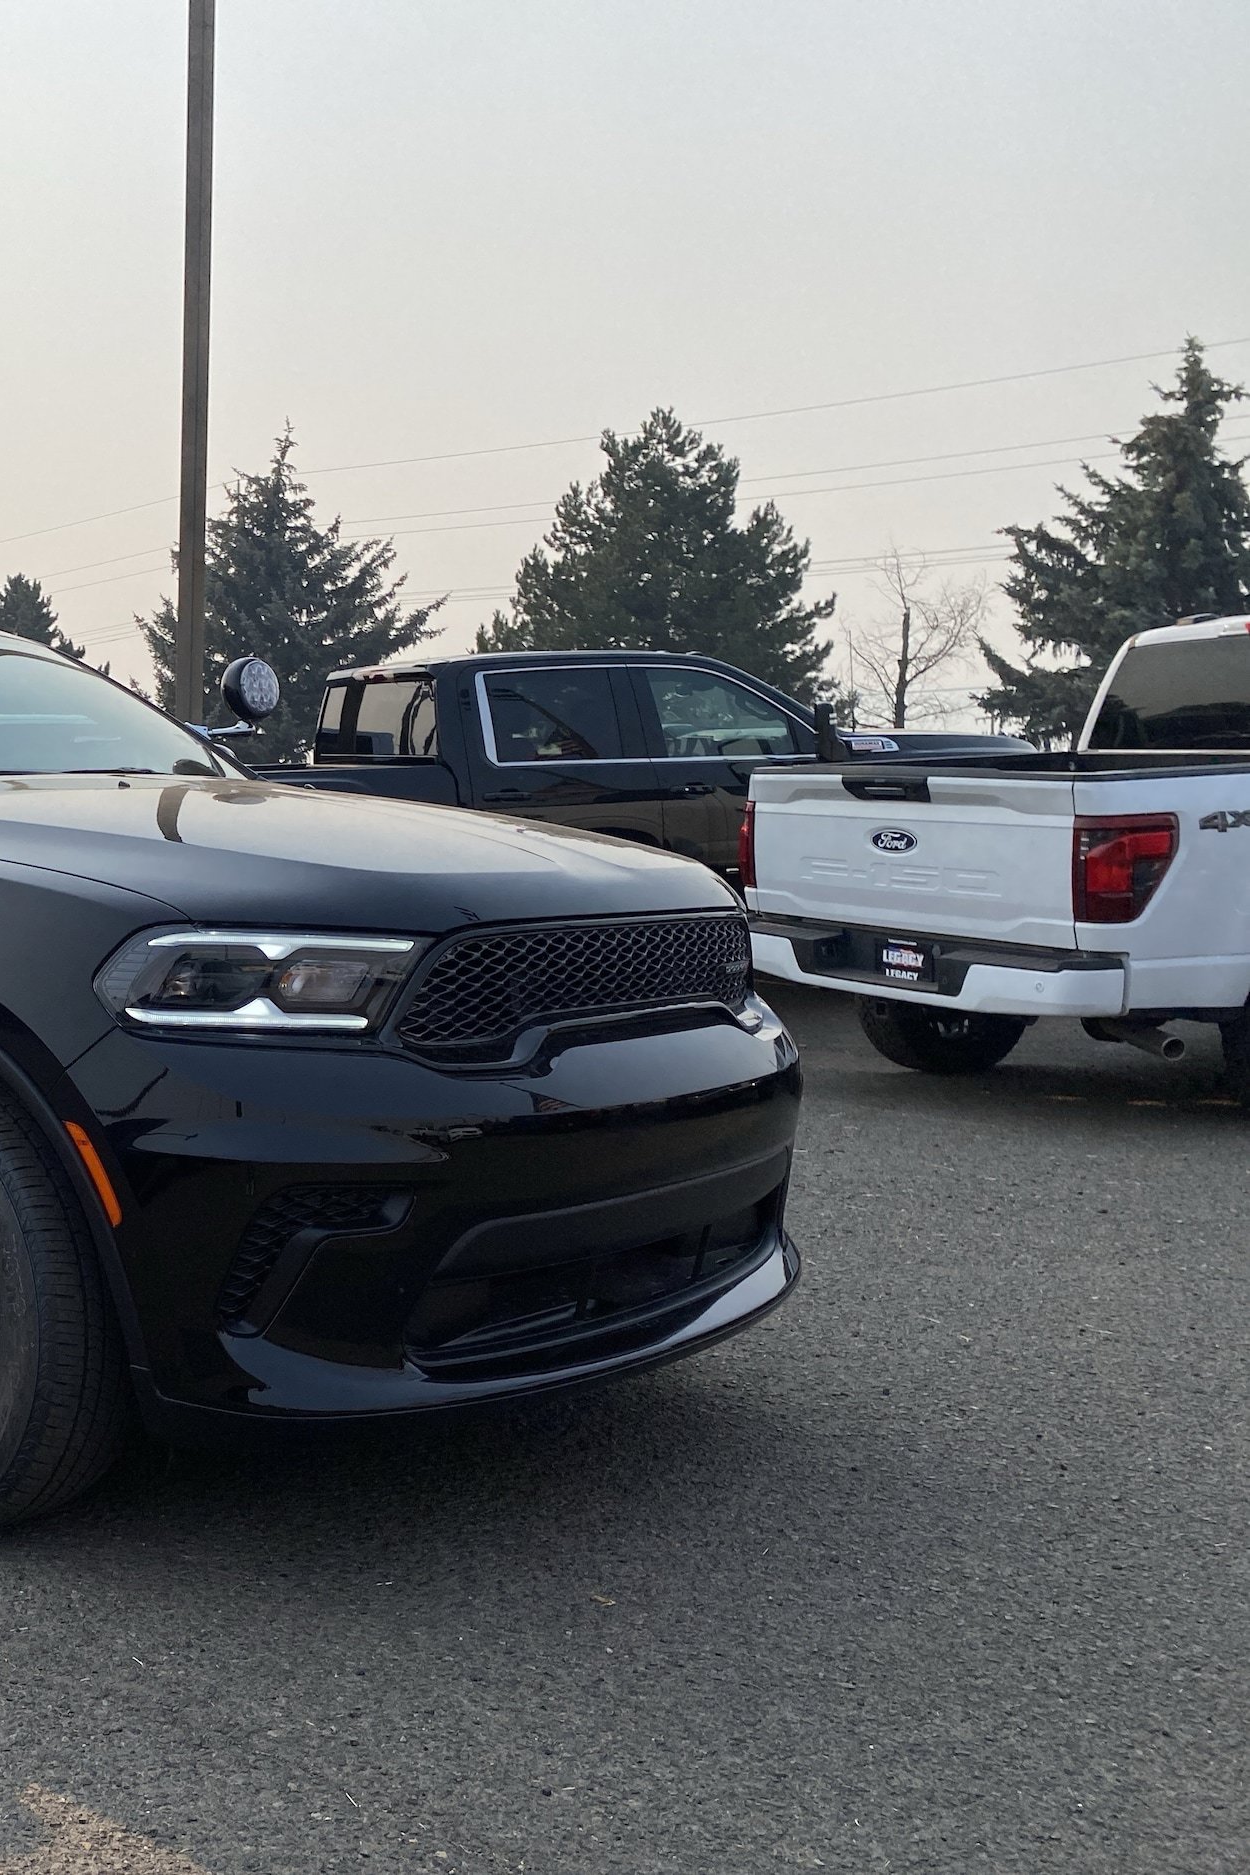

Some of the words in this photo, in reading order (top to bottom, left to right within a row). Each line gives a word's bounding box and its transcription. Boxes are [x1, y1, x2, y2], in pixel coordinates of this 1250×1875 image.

[877, 832, 907, 851] Ford
[801, 856, 1001, 897] F-150
[882, 949, 924, 967] LEGACY
[885, 968, 919, 981] LEGACY
